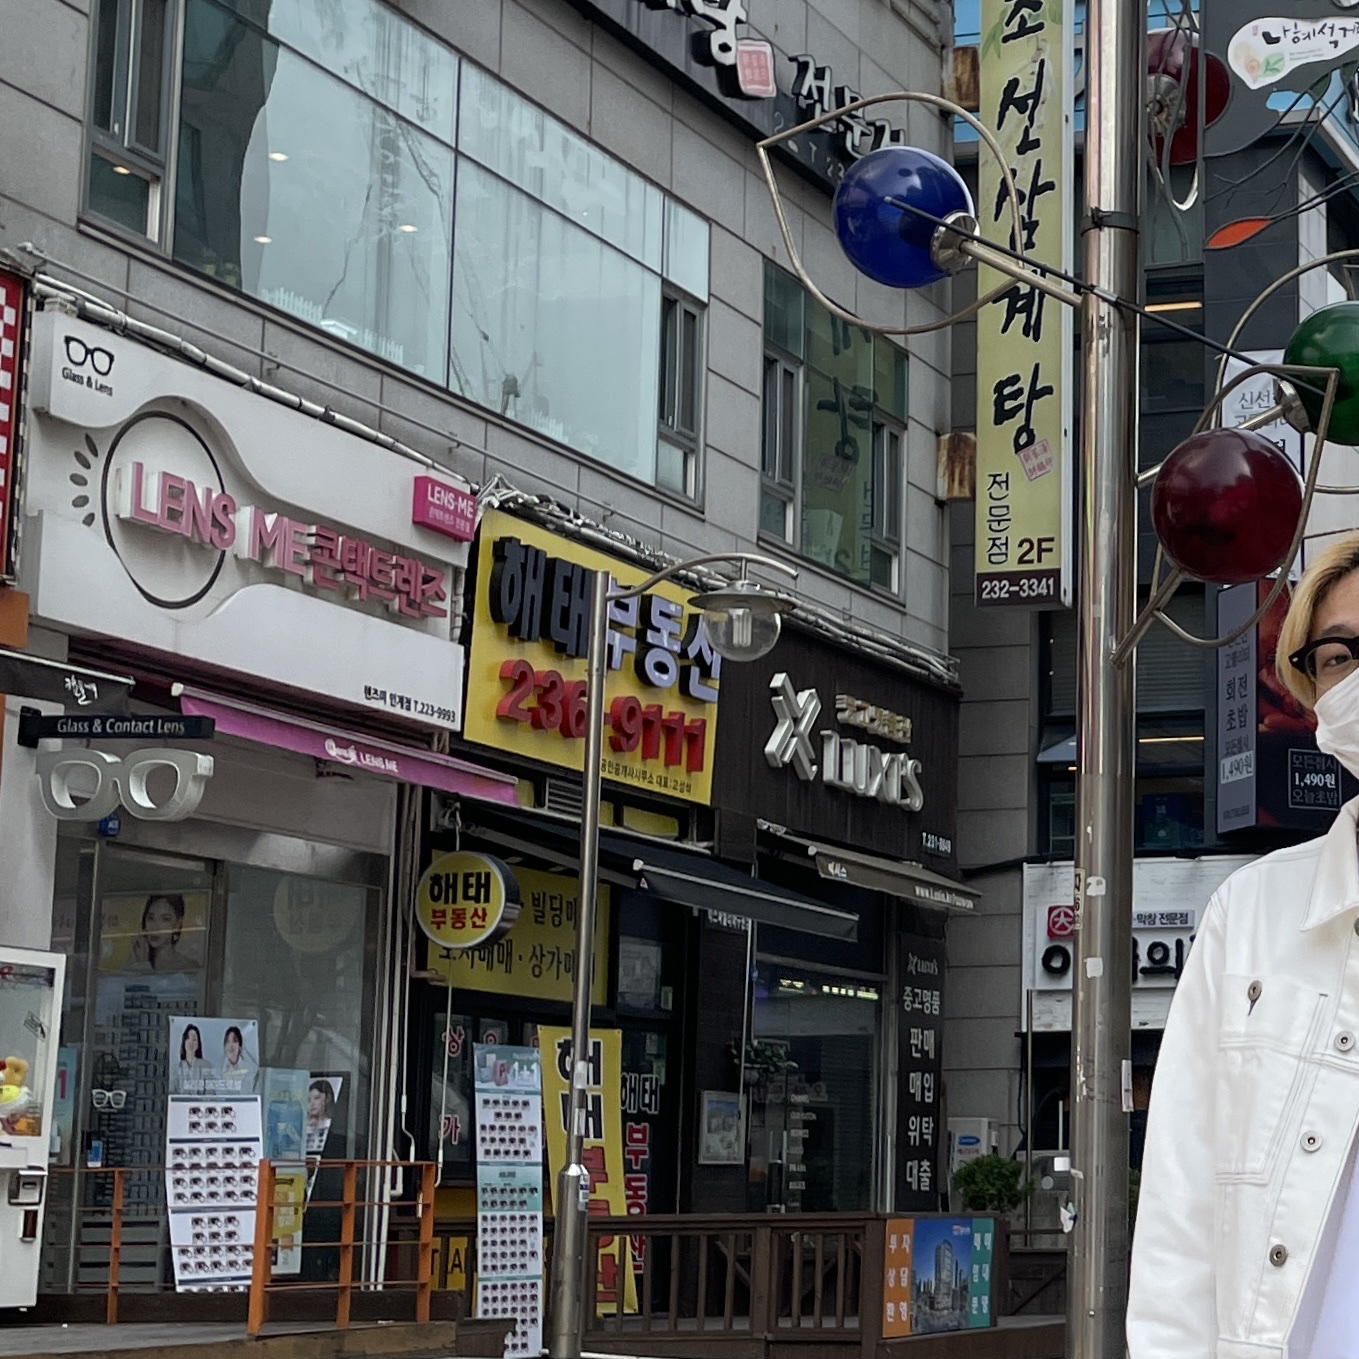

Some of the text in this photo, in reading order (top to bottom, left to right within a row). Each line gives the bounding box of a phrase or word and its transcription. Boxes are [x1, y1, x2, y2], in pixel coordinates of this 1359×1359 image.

[62, 367, 113, 397] Glass & Lens
[986, 471, 1012, 565] 전문점
[131, 461, 447, 618] LENS ME 콘택트렌즈
[1016, 537, 1055, 565] 2F
[981, 576, 1055, 600] 232-3341
[57, 718, 185, 735] Glass & Contact Lens
[496, 659, 707, 773] 236-9111
[1294, 772, 1336, 788] 1,490원
[428, 871, 491, 905] 해태
[431, 908, 488, 930] 부동산
[1159, 912, 1189, 926] 전문점
[902, 985, 941, 1016] 중고명품
[909, 1027, 936, 1060] 판매
[908, 1072, 935, 1104] 매입
[907, 1115, 935, 1148] 위탁
[905, 1160, 932, 1191] 대출
